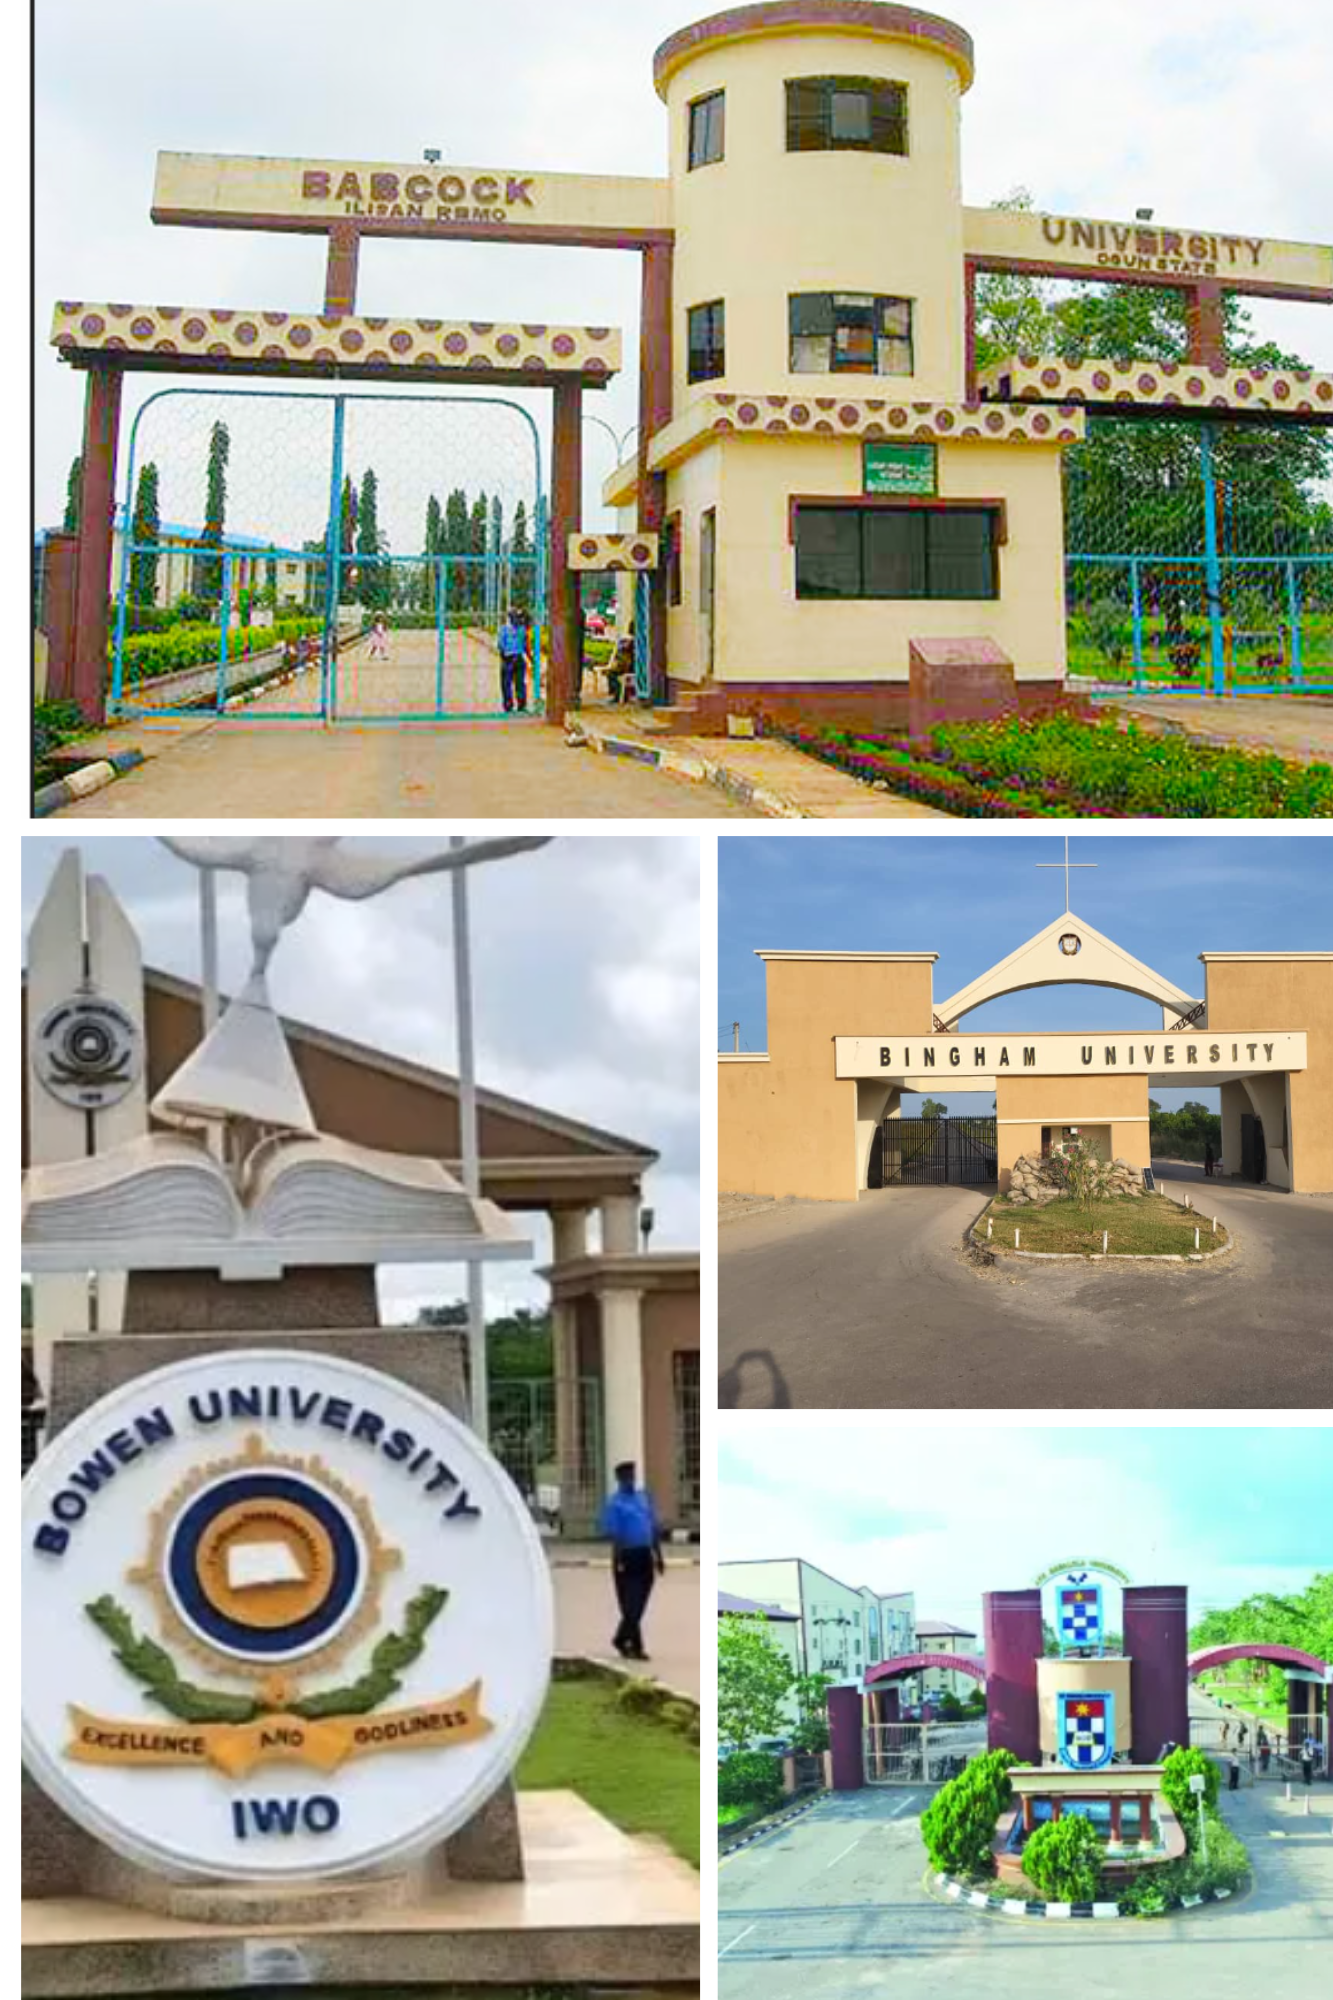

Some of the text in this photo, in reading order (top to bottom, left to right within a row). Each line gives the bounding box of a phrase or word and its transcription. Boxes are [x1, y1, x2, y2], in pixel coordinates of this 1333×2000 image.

[302, 169, 535, 208] BABCOCK
[1042, 216, 1264, 266] UNIVERSITY
[879, 1042, 1274, 1067] BINGHAM UNIVERSITY
[32, 1406, 175, 1557] BOWEN
[188, 1386, 482, 1522] UNIVERSITY
[80, 1709, 468, 1755] EXCELLENCE AND GODLINESS
[231, 1795, 340, 1840] IWO
